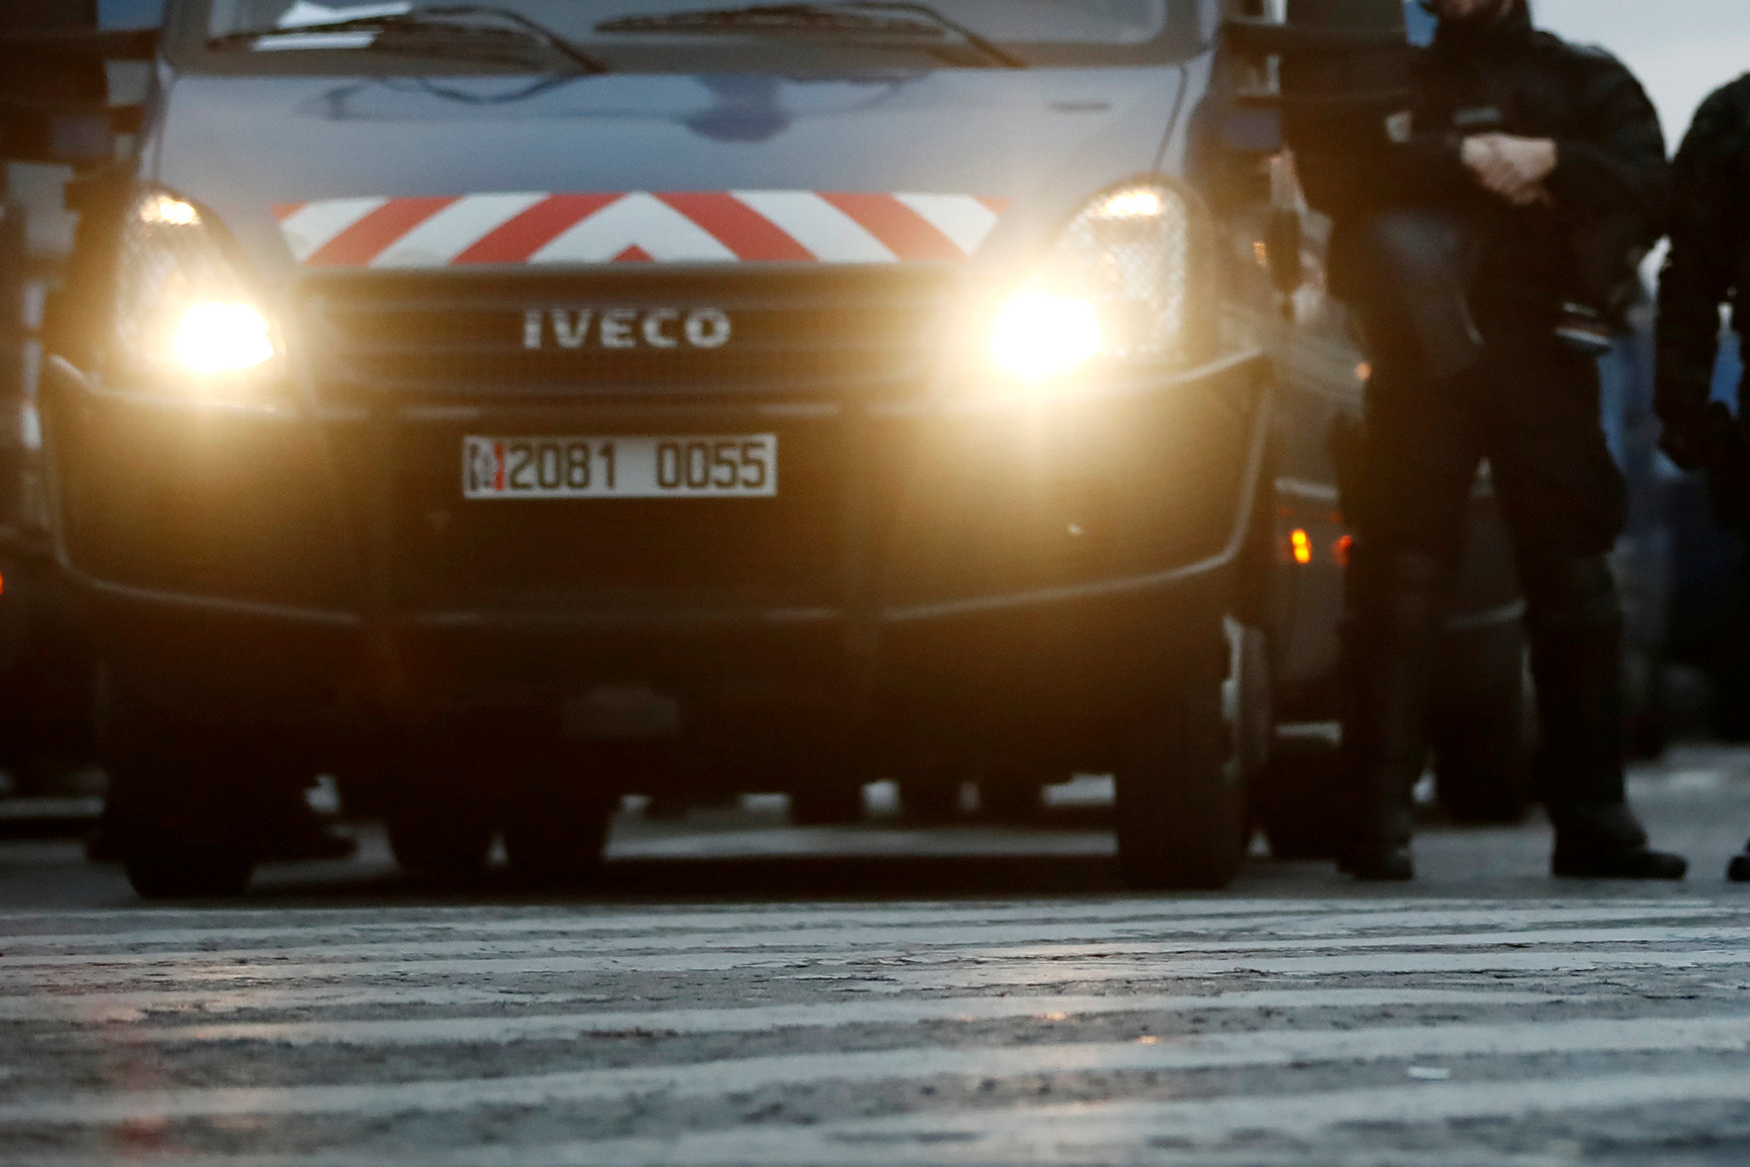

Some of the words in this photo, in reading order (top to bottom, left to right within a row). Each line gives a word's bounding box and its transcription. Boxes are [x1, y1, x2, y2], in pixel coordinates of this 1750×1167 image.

[523, 308, 731, 349] IVECO
[508, 440, 618, 490] 2081
[656, 439, 766, 490] 0055
